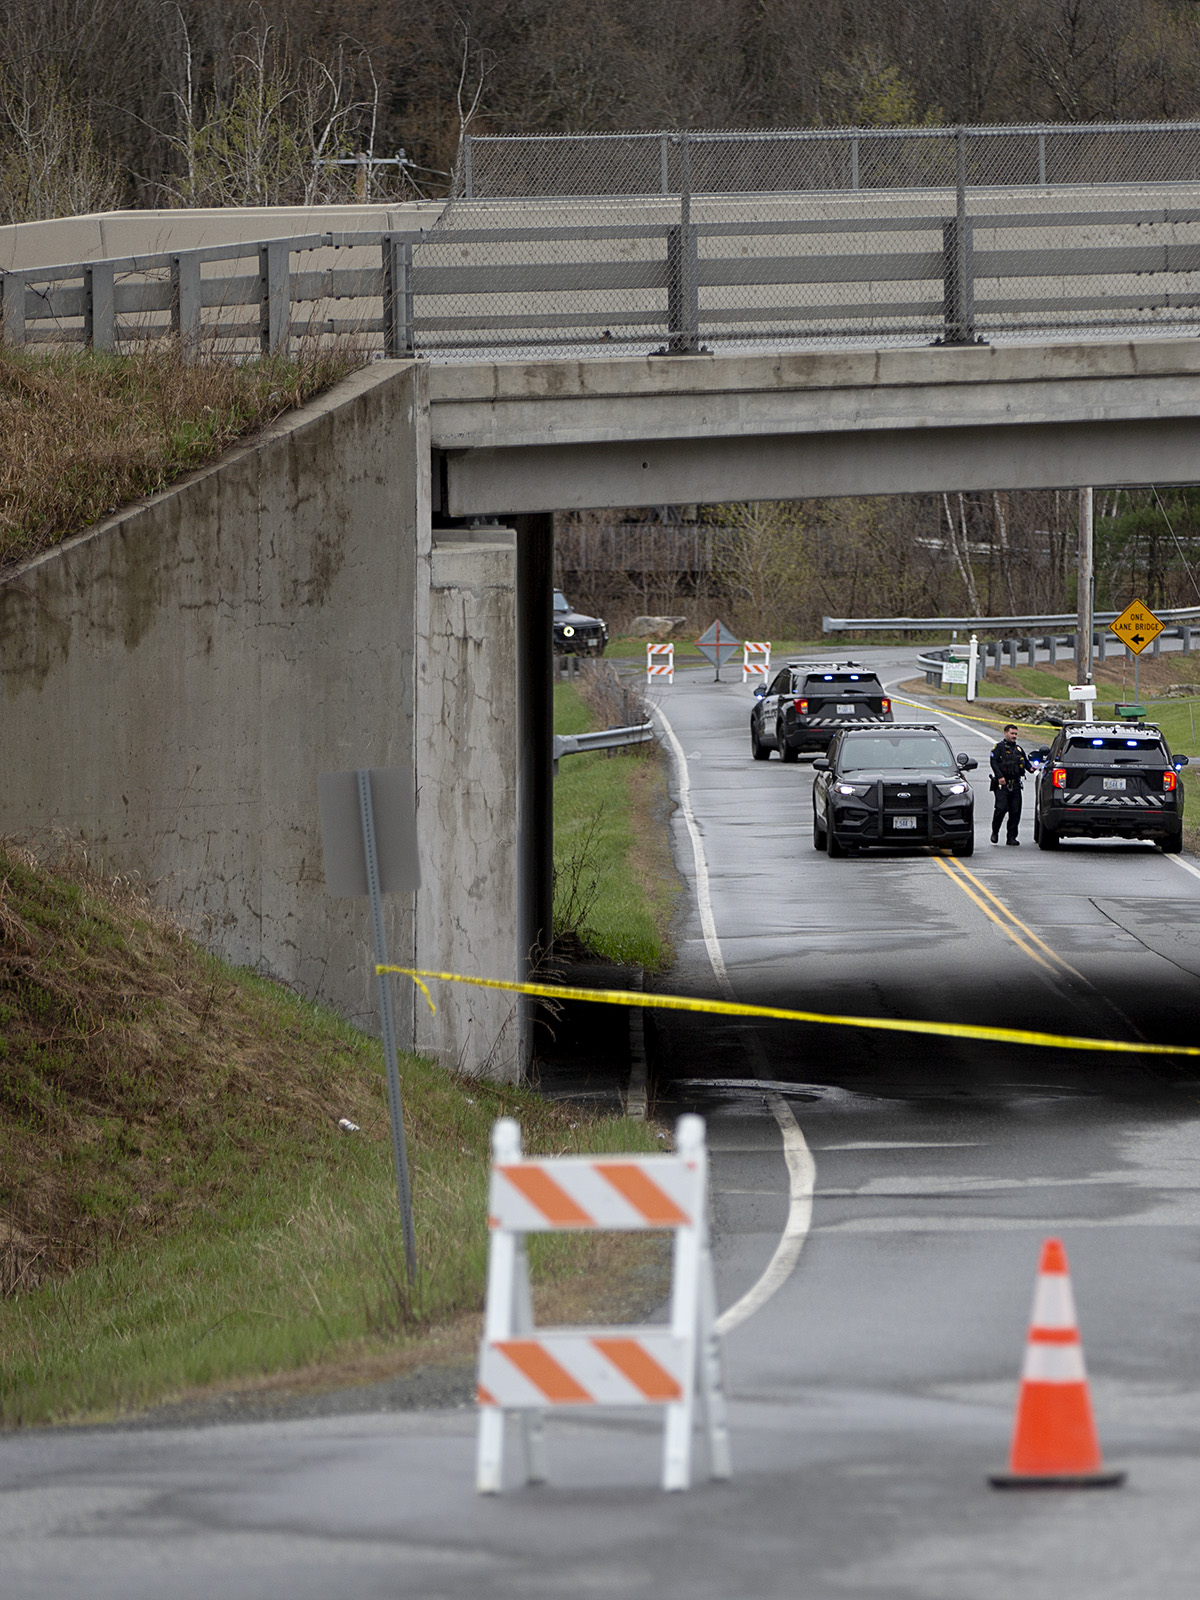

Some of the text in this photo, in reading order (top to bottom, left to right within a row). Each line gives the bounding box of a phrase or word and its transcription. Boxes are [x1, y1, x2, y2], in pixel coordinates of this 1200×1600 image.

[1130, 613, 1144, 621] ONE
[1114, 623, 1160, 631] LANE BRIDGE
